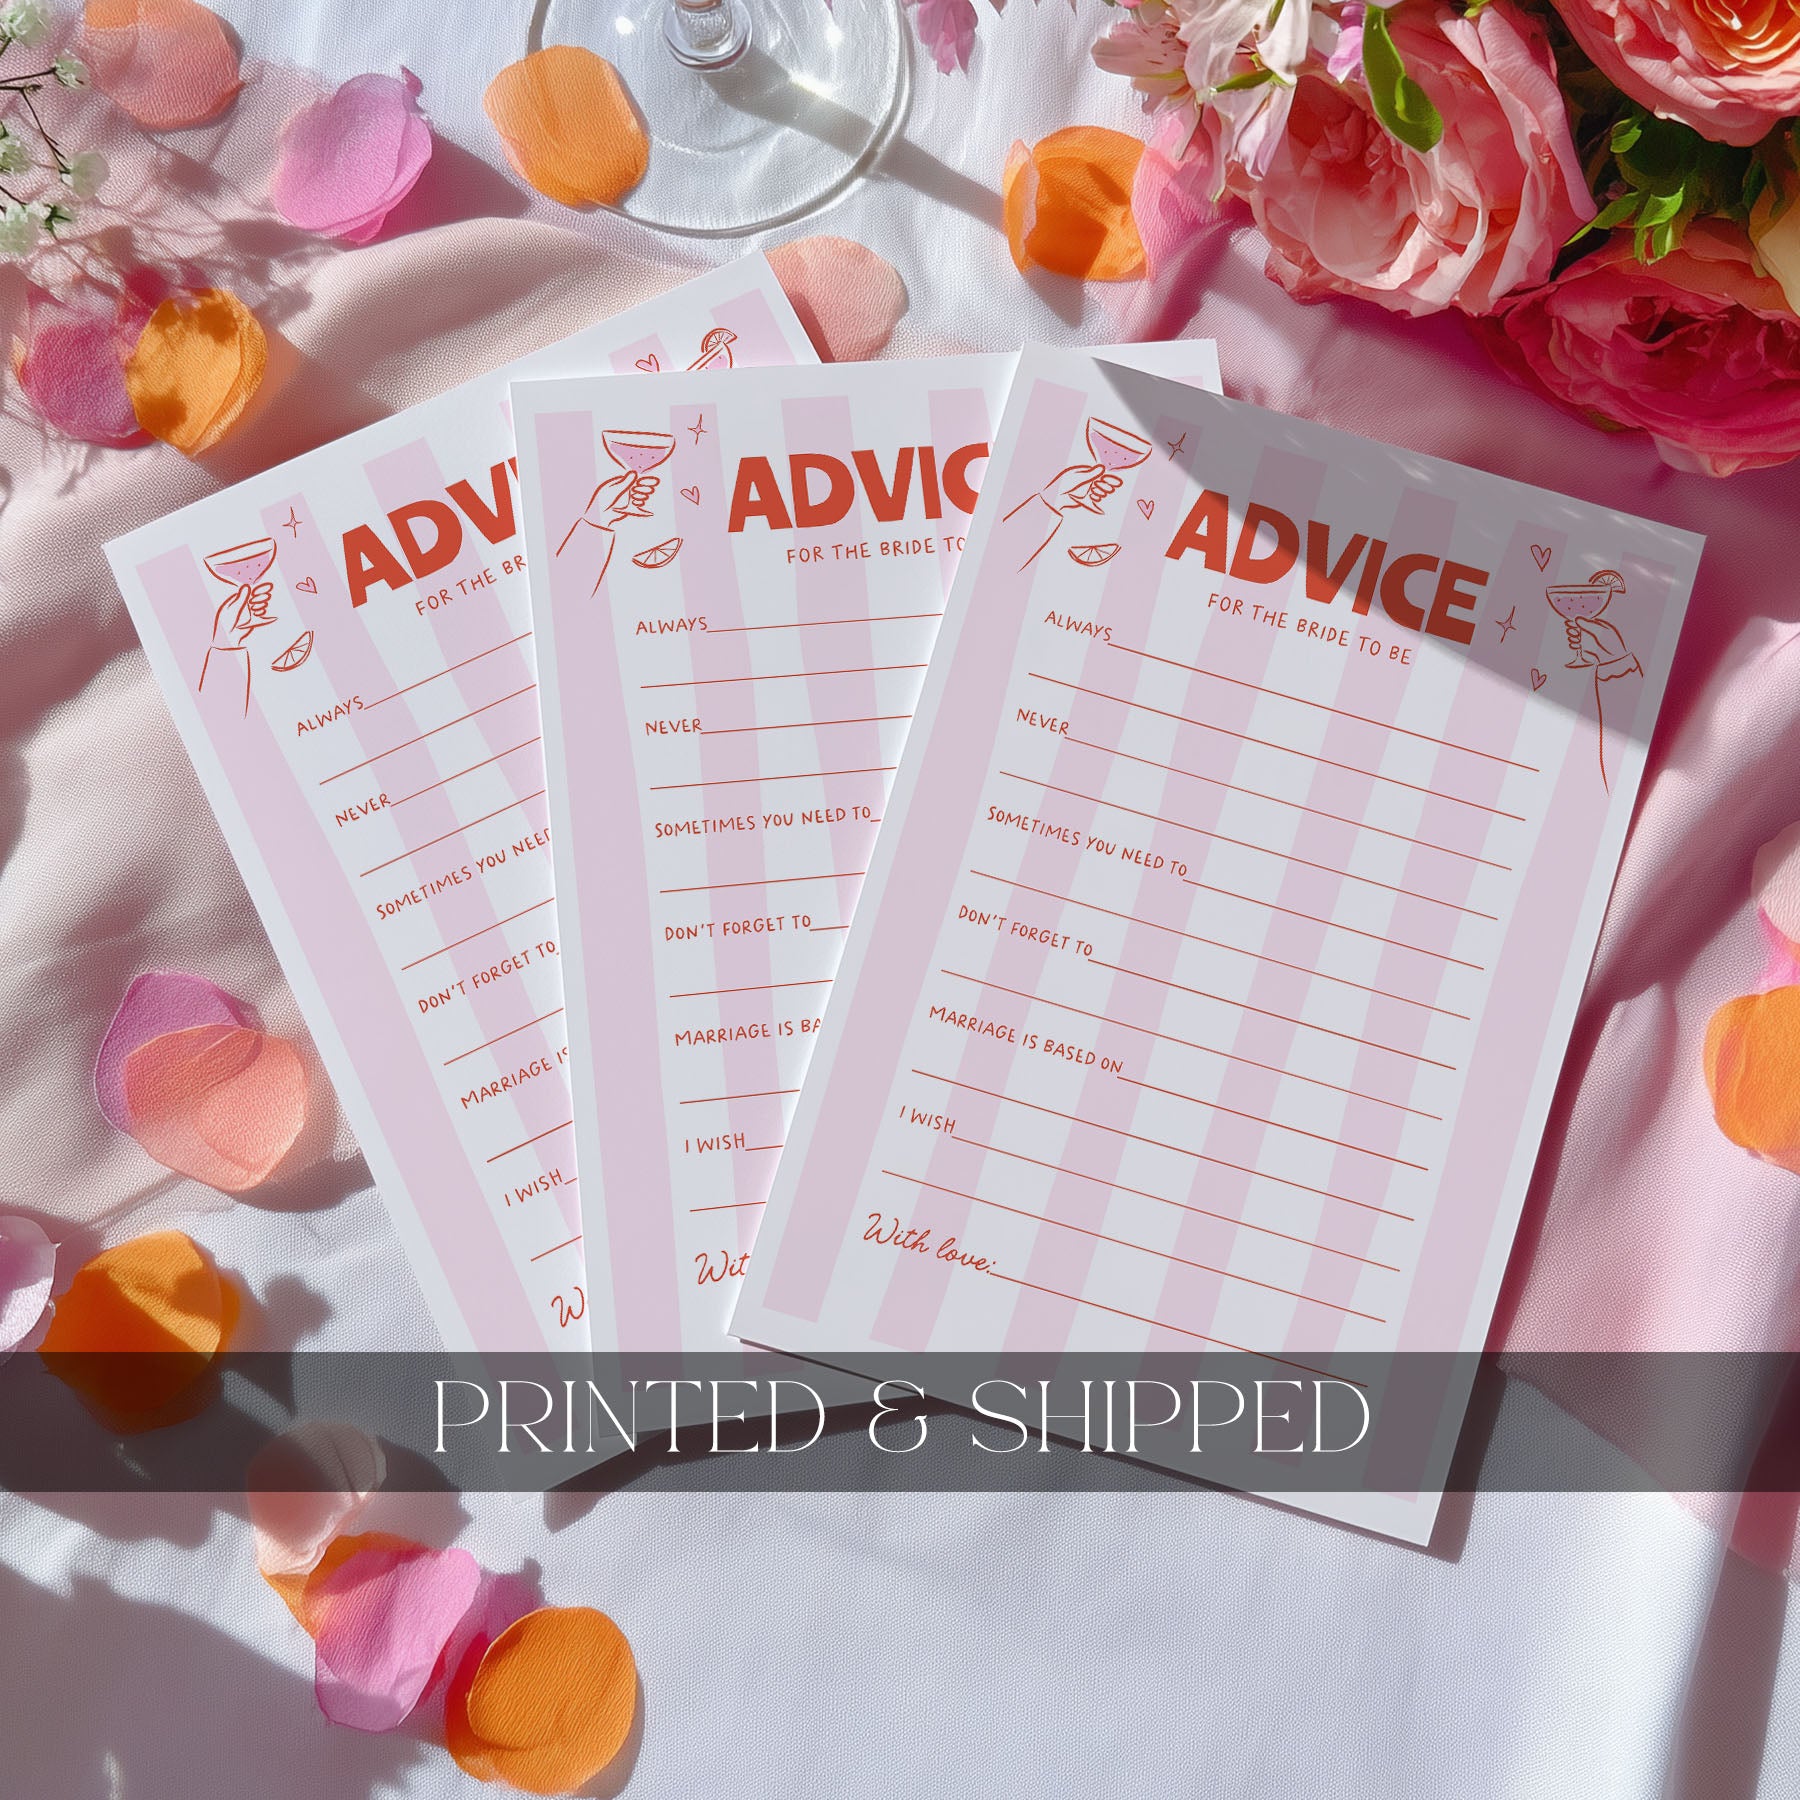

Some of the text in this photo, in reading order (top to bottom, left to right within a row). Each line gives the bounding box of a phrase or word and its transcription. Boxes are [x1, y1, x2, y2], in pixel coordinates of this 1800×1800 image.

[342, 457, 518, 608] ADV
[787, 546, 824, 563] FOR
[832, 542, 870, 560] THE
[880, 538, 934, 556] BRIDE
[1164, 489, 1489, 646] ADVICE
[416, 589, 453, 615] FOR
[456, 568, 496, 595] THE
[636, 616, 708, 634] ALWAYS
[1045, 611, 1112, 641] ALWAYS
[1208, 593, 1410, 665] FOR THE BRIDE TO BE
[298, 696, 364, 736] ALWAYS
[646, 718, 702, 734] NEVER
[1017, 708, 1069, 735] NEVER
[336, 793, 390, 826] NEVER
[656, 806, 870, 838] SOMETIMES YOU NEED TO
[987, 806, 1187, 877] SOMETIMES YOU NEED TO
[376, 866, 472, 920] SOMETIMES
[476, 849, 506, 872] YOU
[665, 915, 810, 940] DON'T FORGET TO
[958, 905, 1092, 956] DON'T FORGET TO
[418, 941, 555, 1013] DON'T FORGET TO
[675, 1024, 770, 1045] MARRIAGE
[778, 1021, 793, 1036] IS
[930, 1007, 1123, 1072] MARRIAGE IS BASED ON
[461, 1058, 552, 1108] MARRIAGE
[899, 1106, 956, 1133] I WISH
[685, 1132, 745, 1153] I WISH
[503, 1168, 563, 1207] I WISH
[864, 1214, 931, 1253] With
